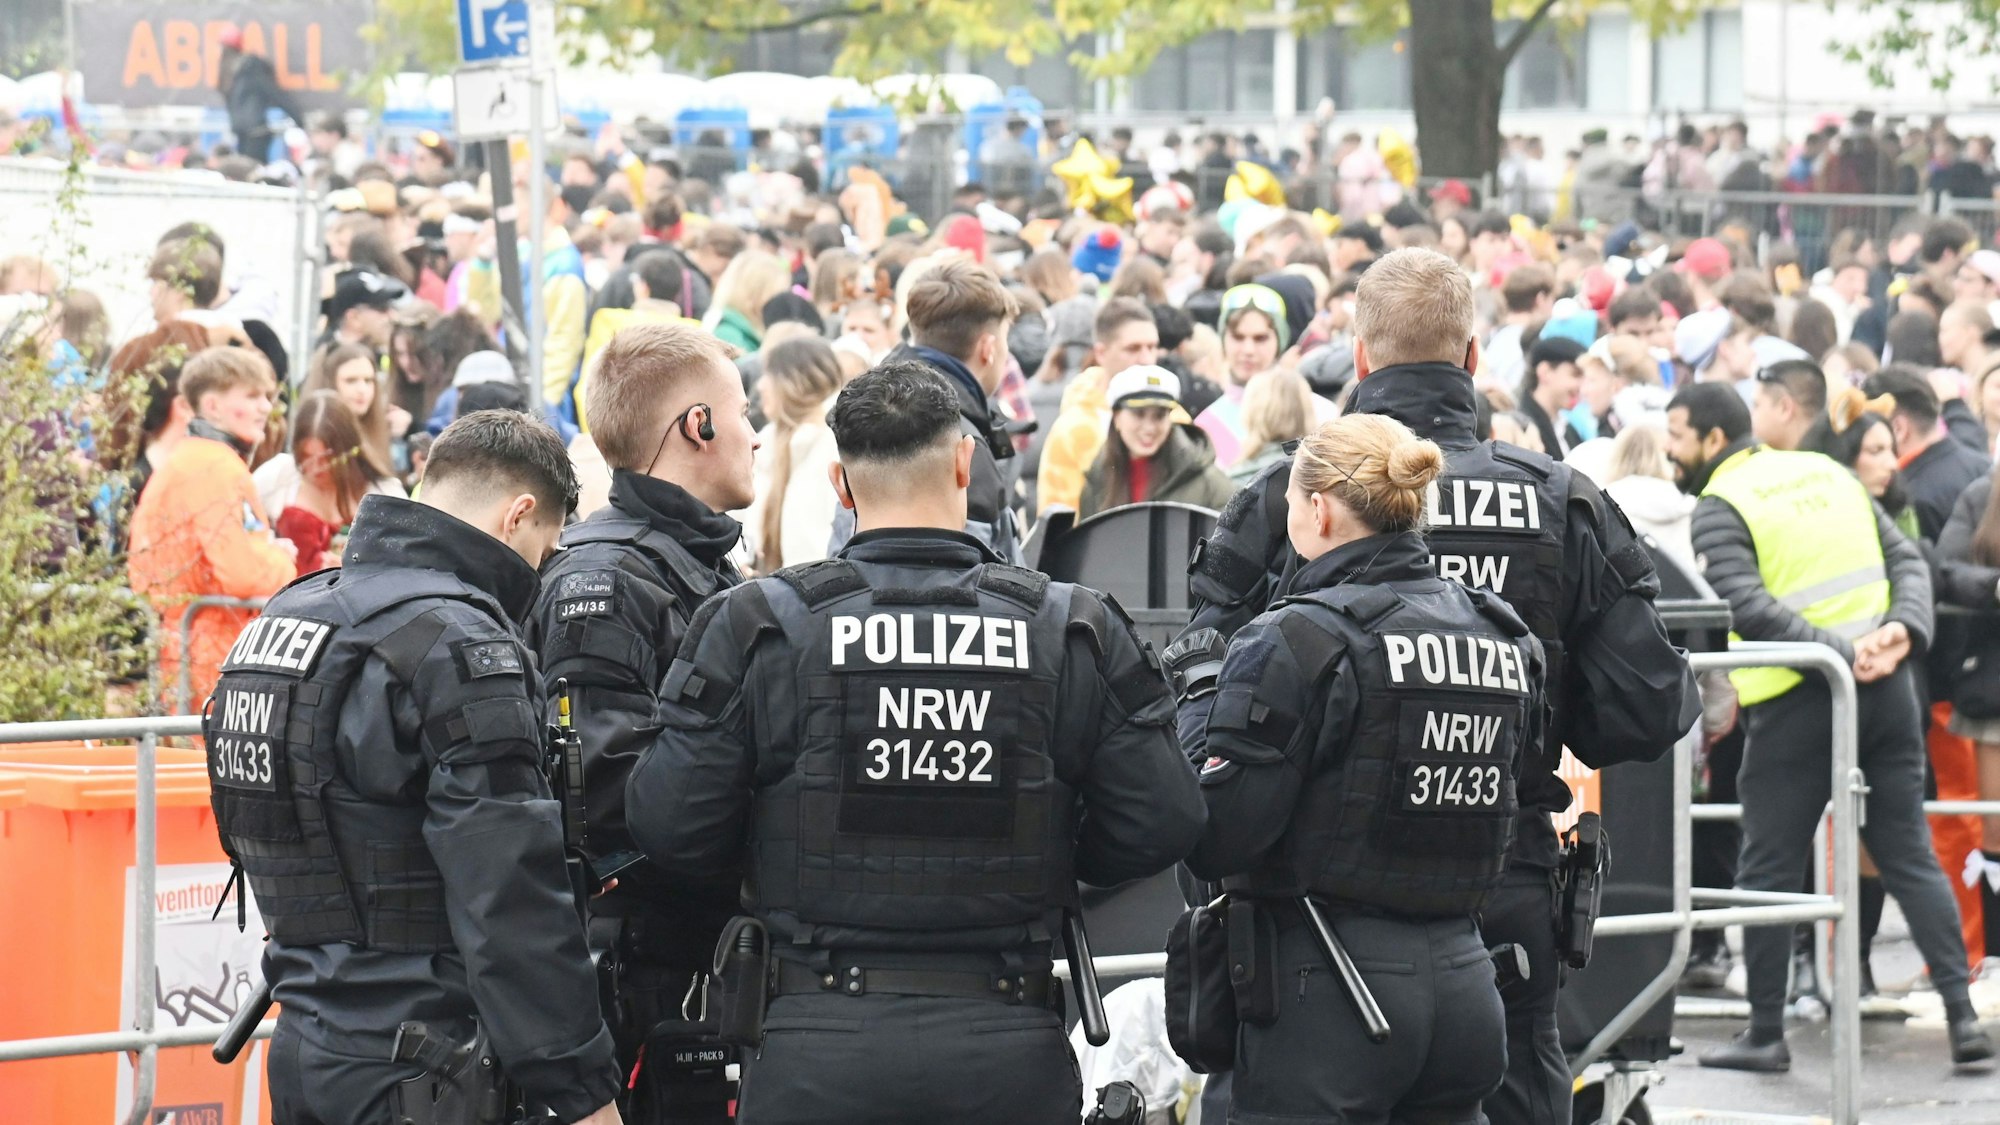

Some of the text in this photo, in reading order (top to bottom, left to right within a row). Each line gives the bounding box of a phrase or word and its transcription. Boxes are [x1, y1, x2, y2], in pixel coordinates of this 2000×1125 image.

[1425, 480, 1541, 530] LIZEI
[831, 613, 1030, 670] POLIZEI
[1383, 633, 1530, 693] POLIZEI
[222, 689, 275, 735] NRW
[877, 686, 992, 732] NRW
[1421, 710, 1503, 755] NRW
[215, 736, 272, 784] 31433
[865, 738, 994, 783] 31432
[1410, 764, 1501, 806] 31433
[699, 1050, 718, 1061] PACK
[718, 1050, 724, 1060] 9
